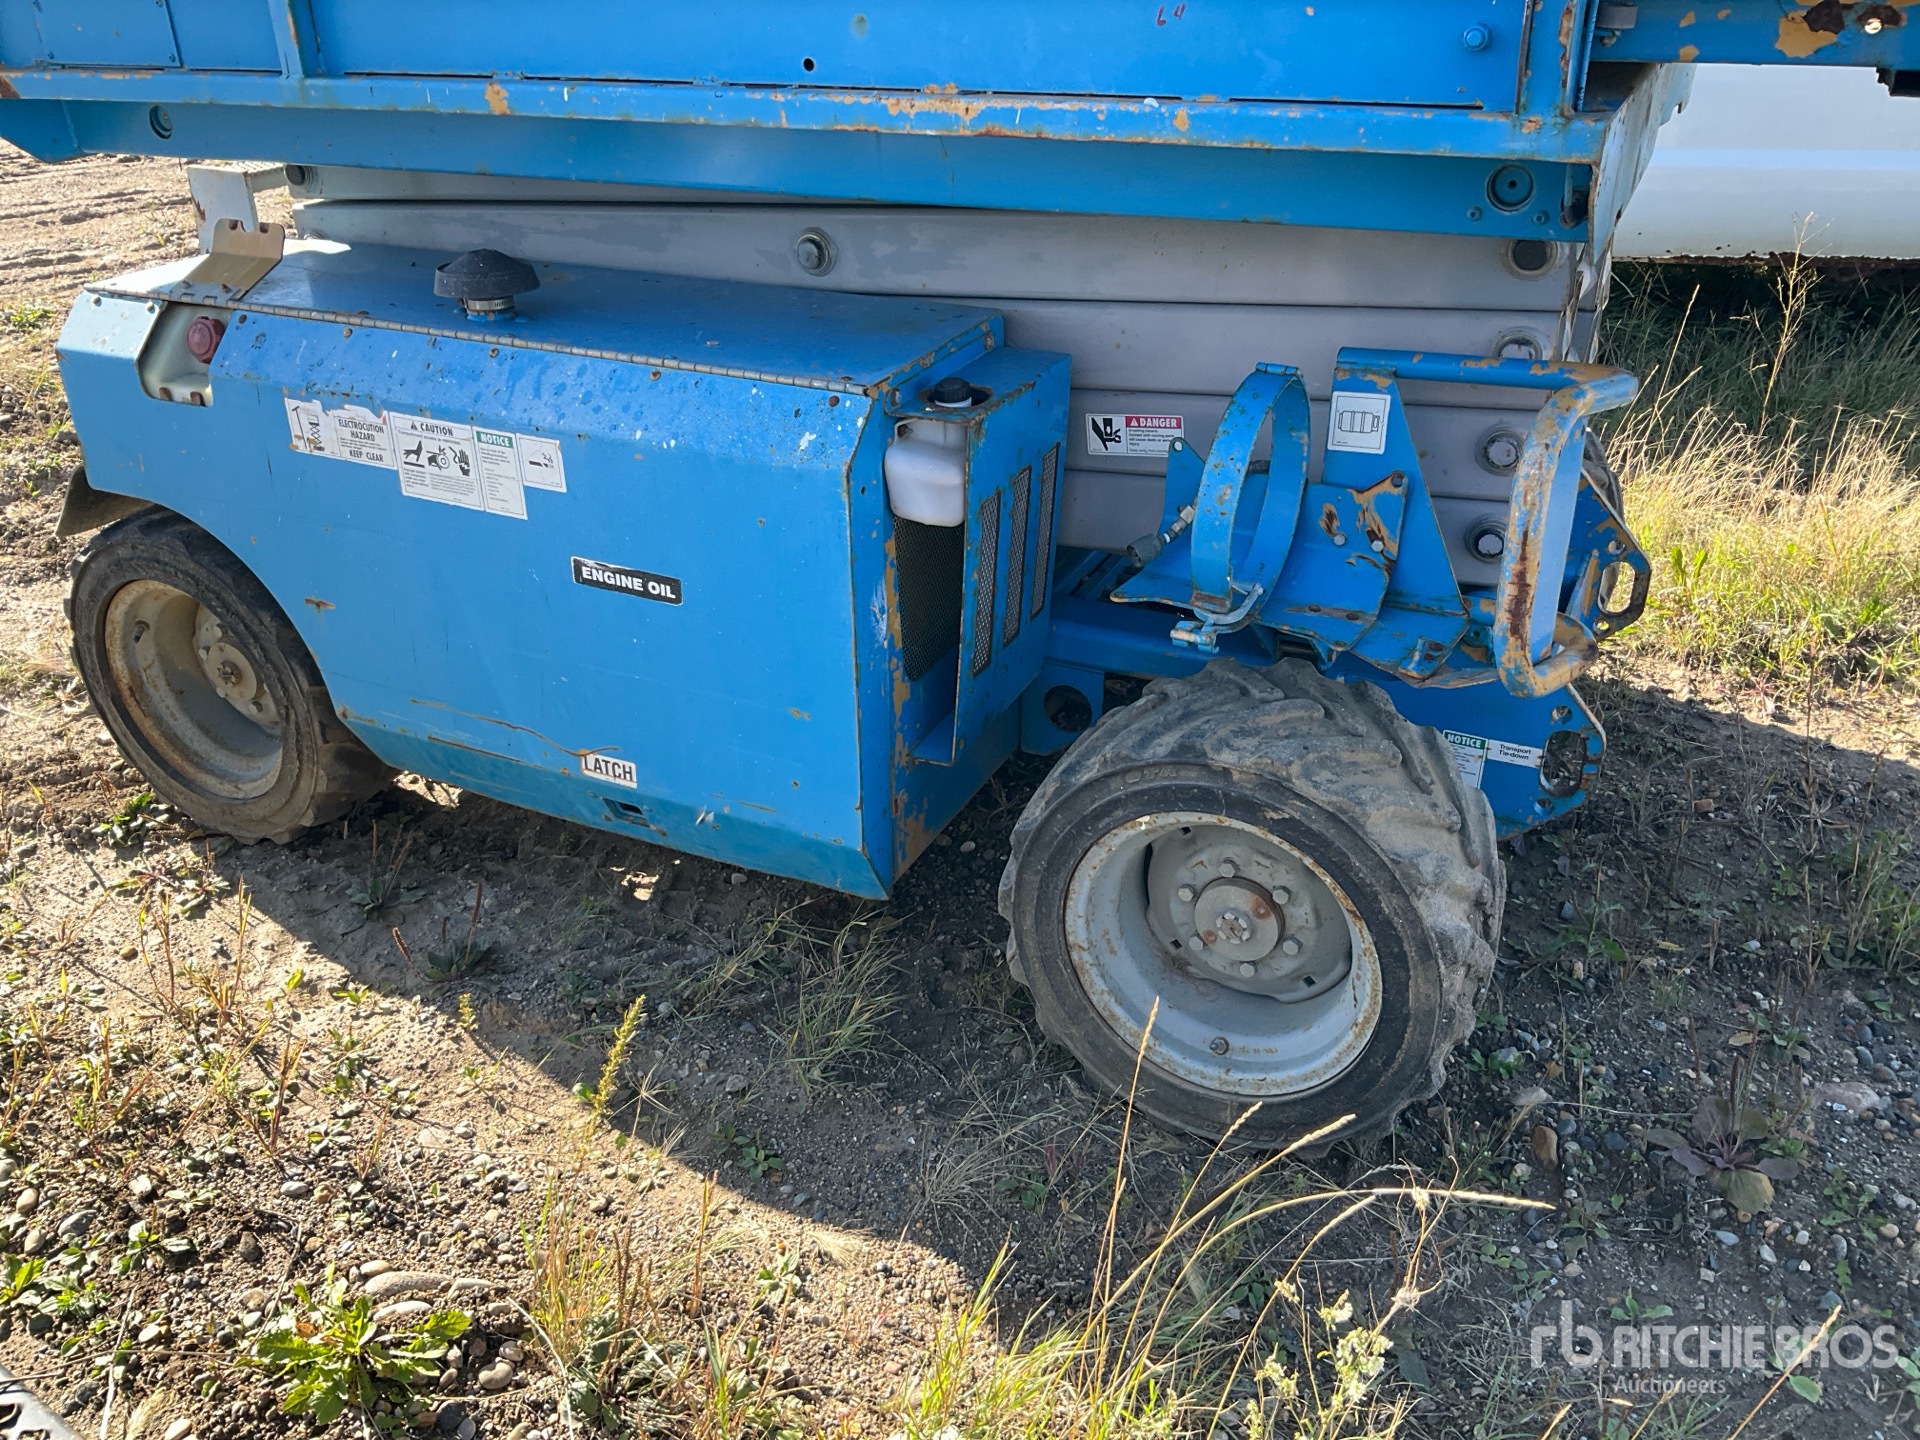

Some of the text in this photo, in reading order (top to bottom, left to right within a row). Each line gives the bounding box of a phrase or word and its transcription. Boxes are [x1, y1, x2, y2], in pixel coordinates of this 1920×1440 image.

[338, 418, 385, 434] ELECTROCUTION
[420, 422, 454, 437] CAUTION
[1139, 417, 1178, 428] DANGER
[350, 430, 376, 442] HAZARD
[480, 433, 511, 447] NOTICE
[349, 449, 385, 462] KEEP CLEAR
[581, 566, 676, 599] ENGINE OIL
[1447, 733, 1482, 748] NOTICE
[1499, 743, 1532, 755] Transport
[1499, 749, 1530, 760] Tie-down
[584, 755, 633, 782] LATCH
